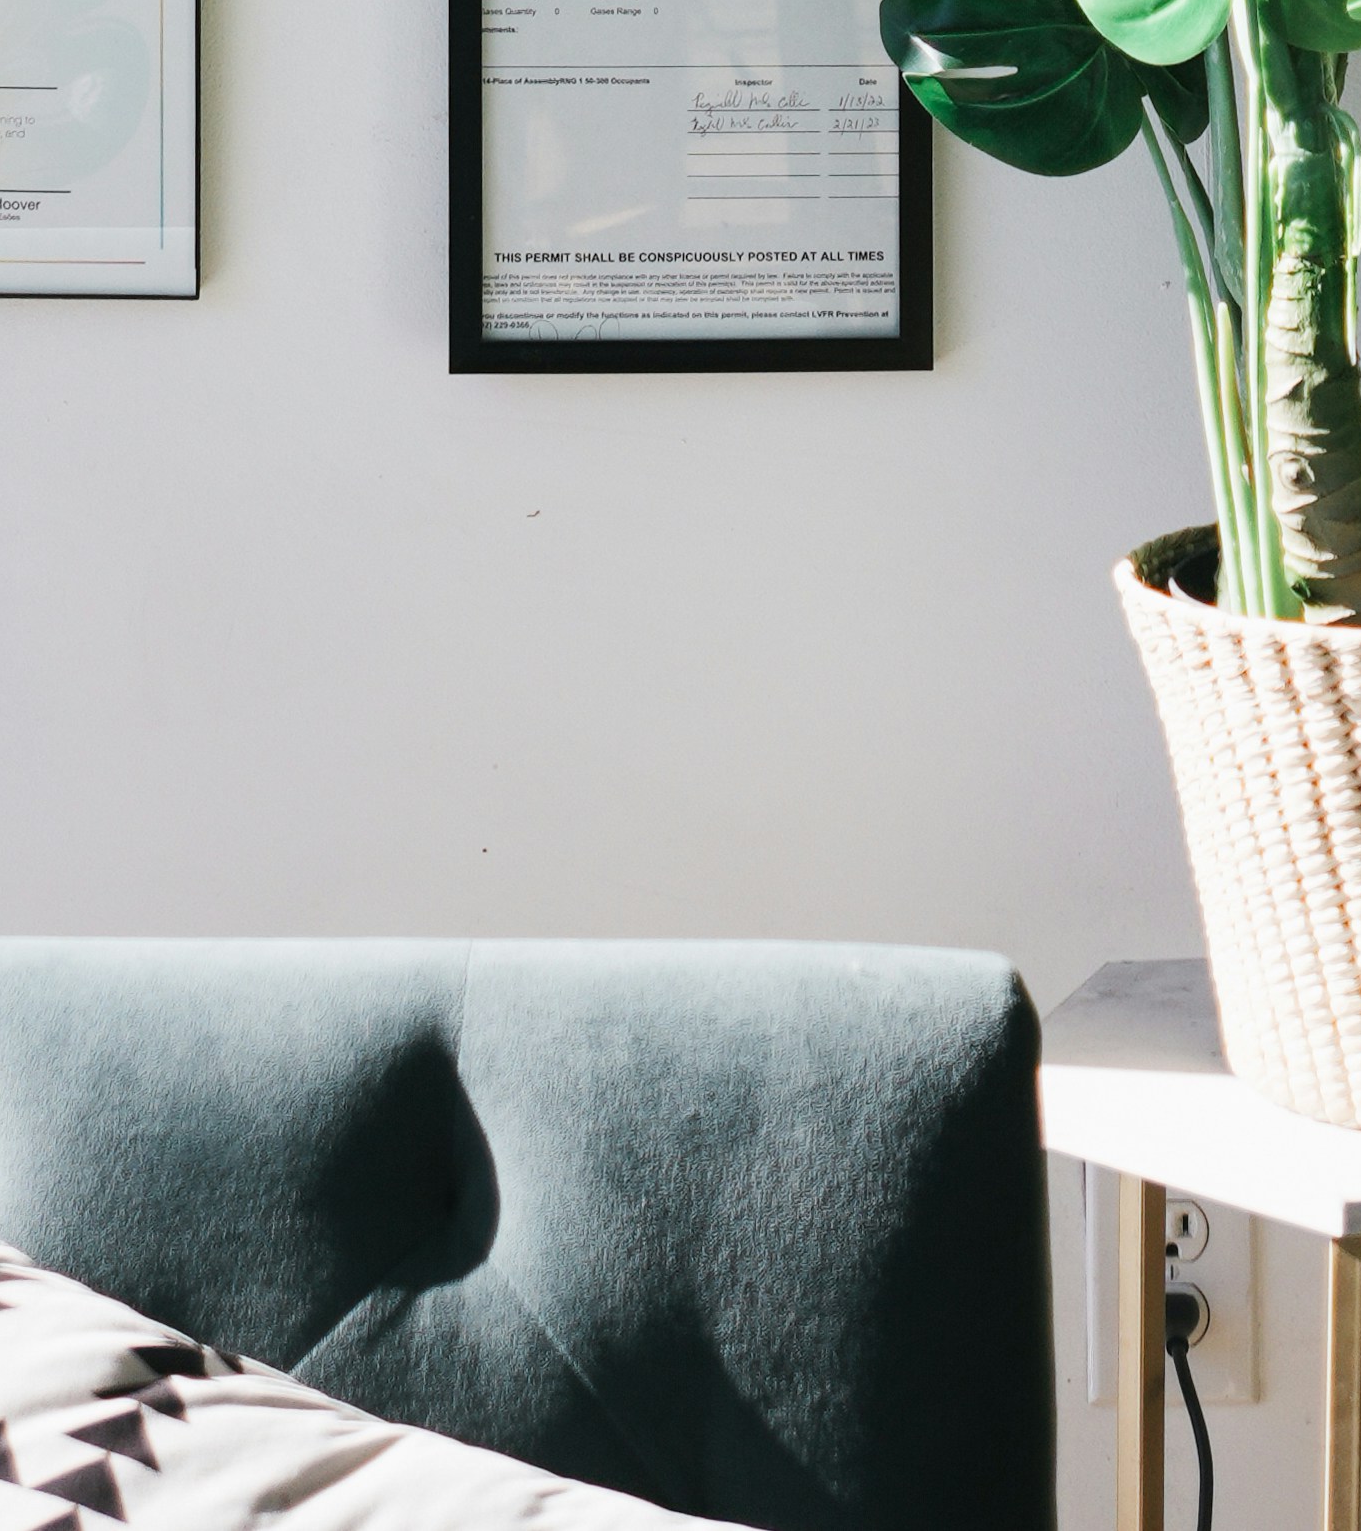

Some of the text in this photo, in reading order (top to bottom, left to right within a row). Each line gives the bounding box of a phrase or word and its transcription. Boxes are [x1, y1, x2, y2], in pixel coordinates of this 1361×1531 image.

[493, 250, 885, 263] THIS PERMIT SHALL BE CONSPICUOUSLY POSTED AT ALL TIMES
